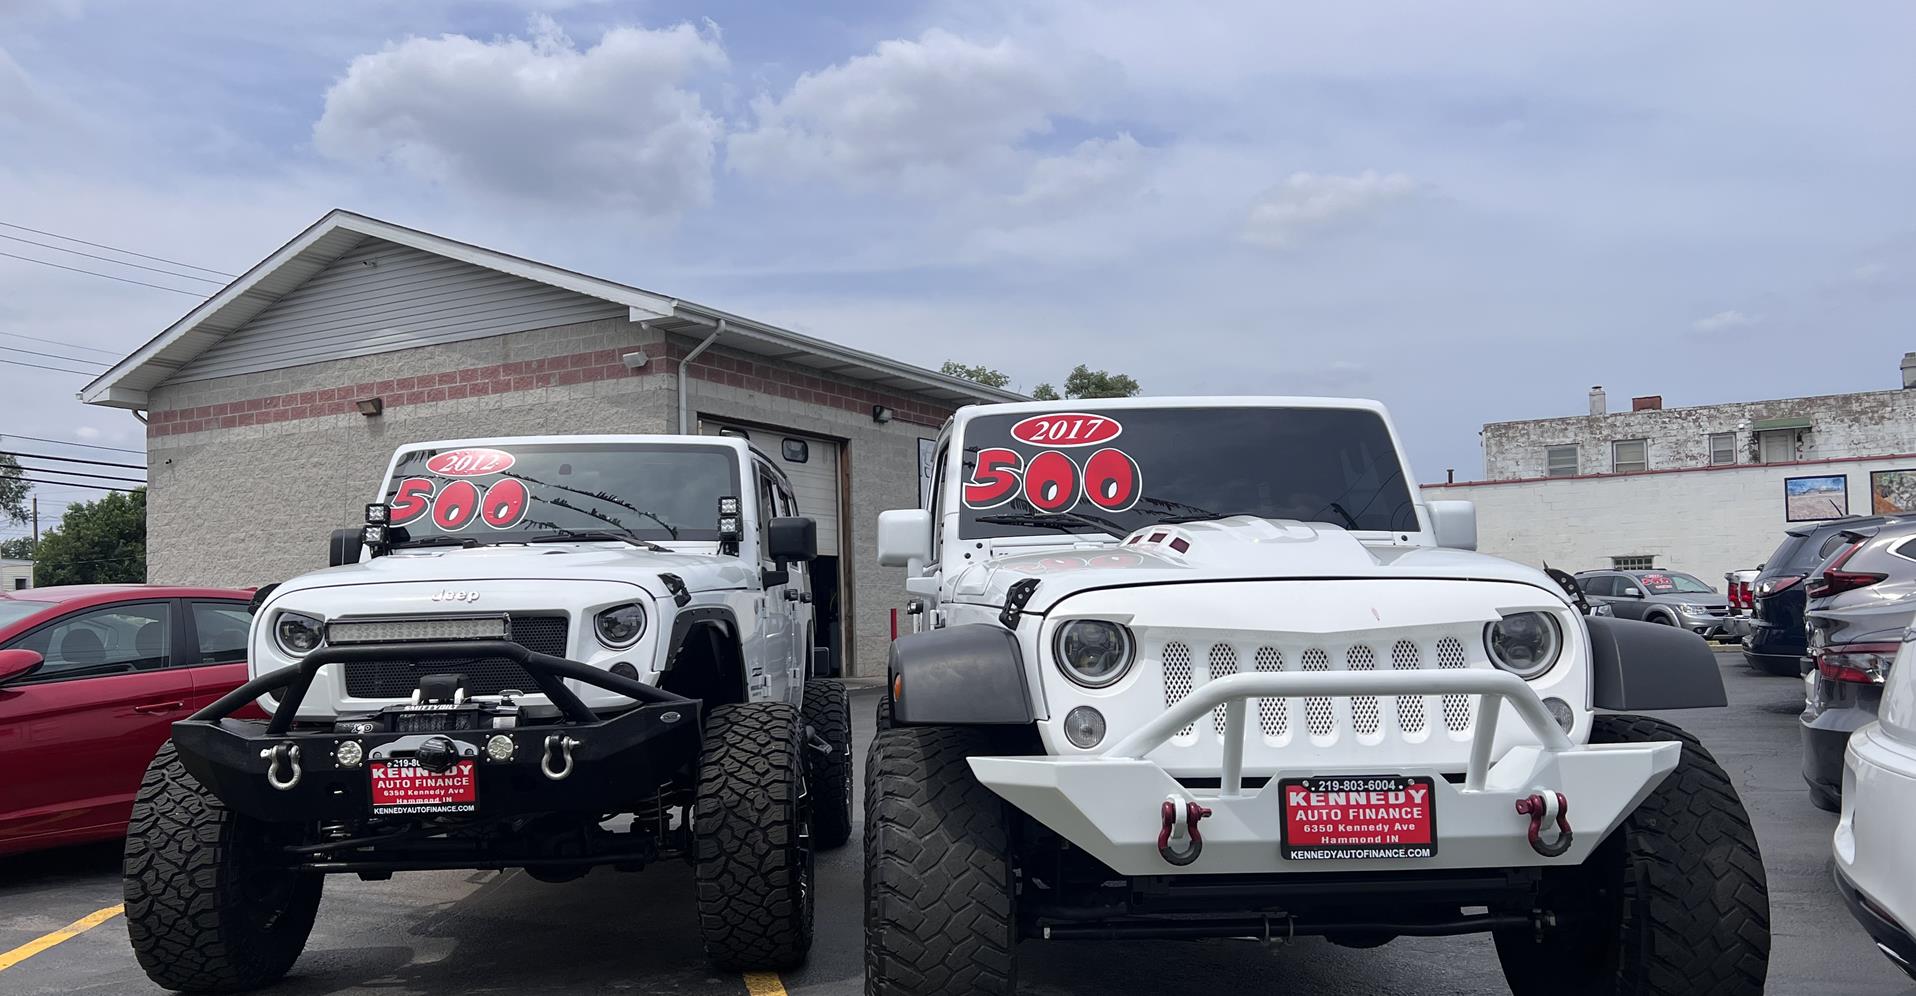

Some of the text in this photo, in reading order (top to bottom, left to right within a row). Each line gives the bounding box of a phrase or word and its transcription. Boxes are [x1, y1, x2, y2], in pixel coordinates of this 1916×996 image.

[1029, 419, 1104, 441] 2017
[441, 453, 499, 473] 2012
[962, 448, 1142, 514] 500
[390, 478, 530, 531] 500
[431, 589, 480, 604] Jeep
[372, 765, 473, 779] KENNDY
[377, 777, 469, 789] AUTO FINANCE
[1318, 780, 1396, 791] 219-803-6004
[407, 788, 445, 796] Kennedy
[1289, 789, 1427, 806] KENNEDY
[374, 805, 475, 815] KENNEDYAUTOFINANCE.COM
[1295, 807, 1423, 821] AUTO FINANCE
[1304, 822, 1416, 832] 6350 Kennedy Ave
[1321, 835, 1399, 844] Hammond IN
[1290, 848, 1431, 860] KENNEDYAUTOFINANCE.COM
